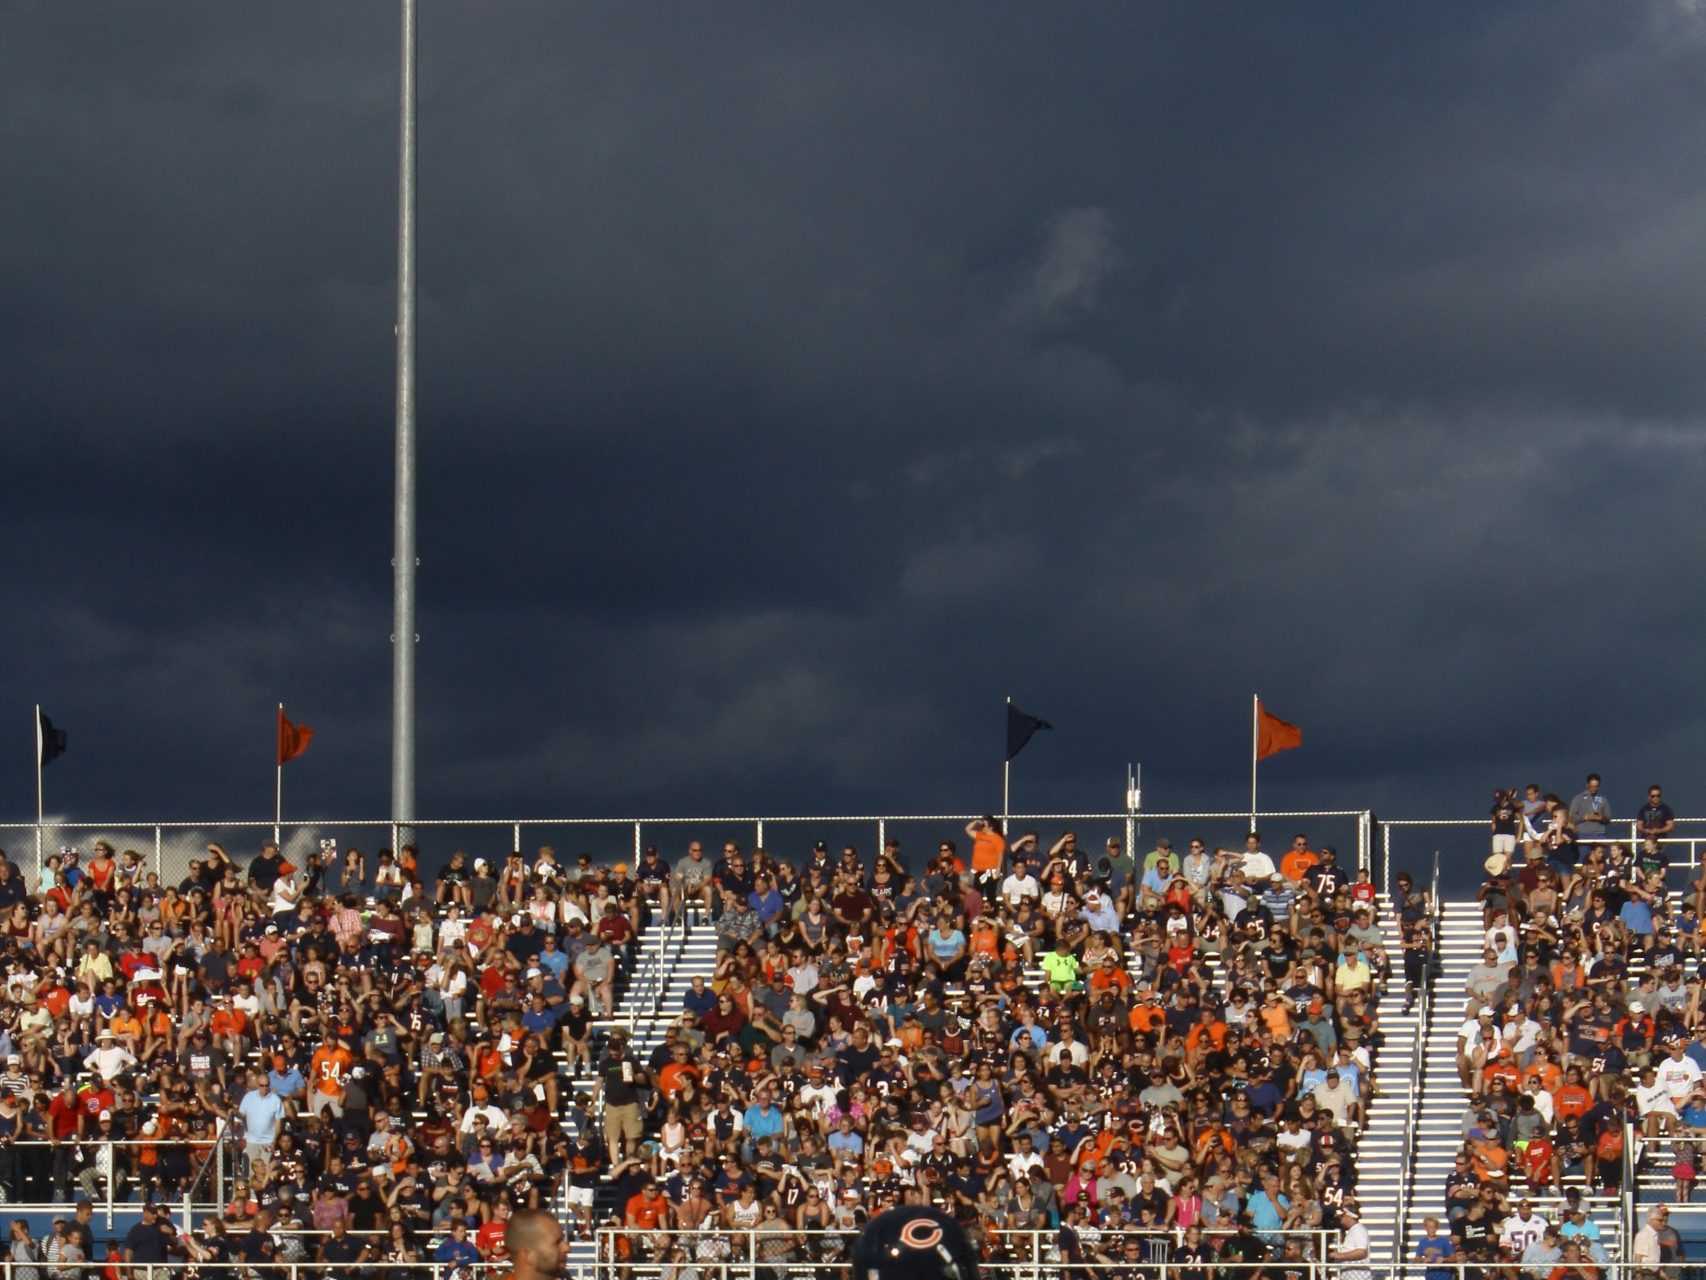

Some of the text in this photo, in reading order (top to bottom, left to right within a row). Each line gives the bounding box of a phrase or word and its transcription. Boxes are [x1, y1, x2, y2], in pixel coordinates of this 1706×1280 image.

[1316, 873, 1336, 895] 75
[322, 1060, 341, 1081] 54
[787, 1188, 799, 1205] 17
[1323, 1186, 1344, 1207] 54
[901, 1218, 944, 1249] C
[1510, 1230, 1538, 1253] 50
